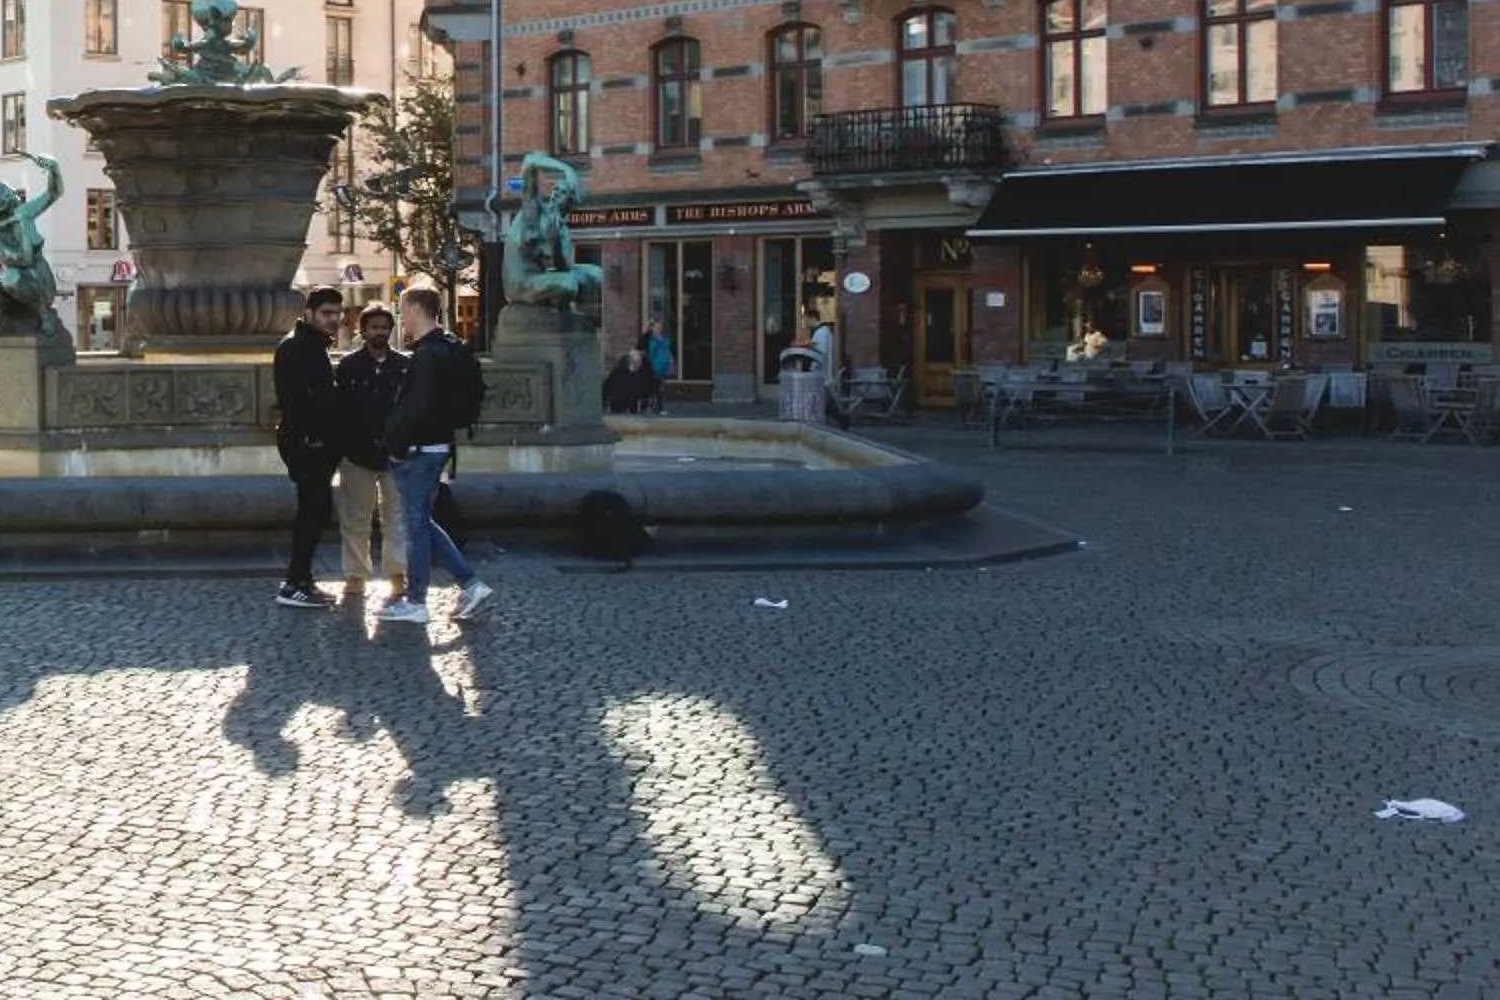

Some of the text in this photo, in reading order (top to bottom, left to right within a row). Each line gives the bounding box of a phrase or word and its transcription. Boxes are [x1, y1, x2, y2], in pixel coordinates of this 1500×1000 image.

[570, 210, 649, 225] HOPS ARMS
[676, 202, 817, 220] THE BISHOPS ARM
